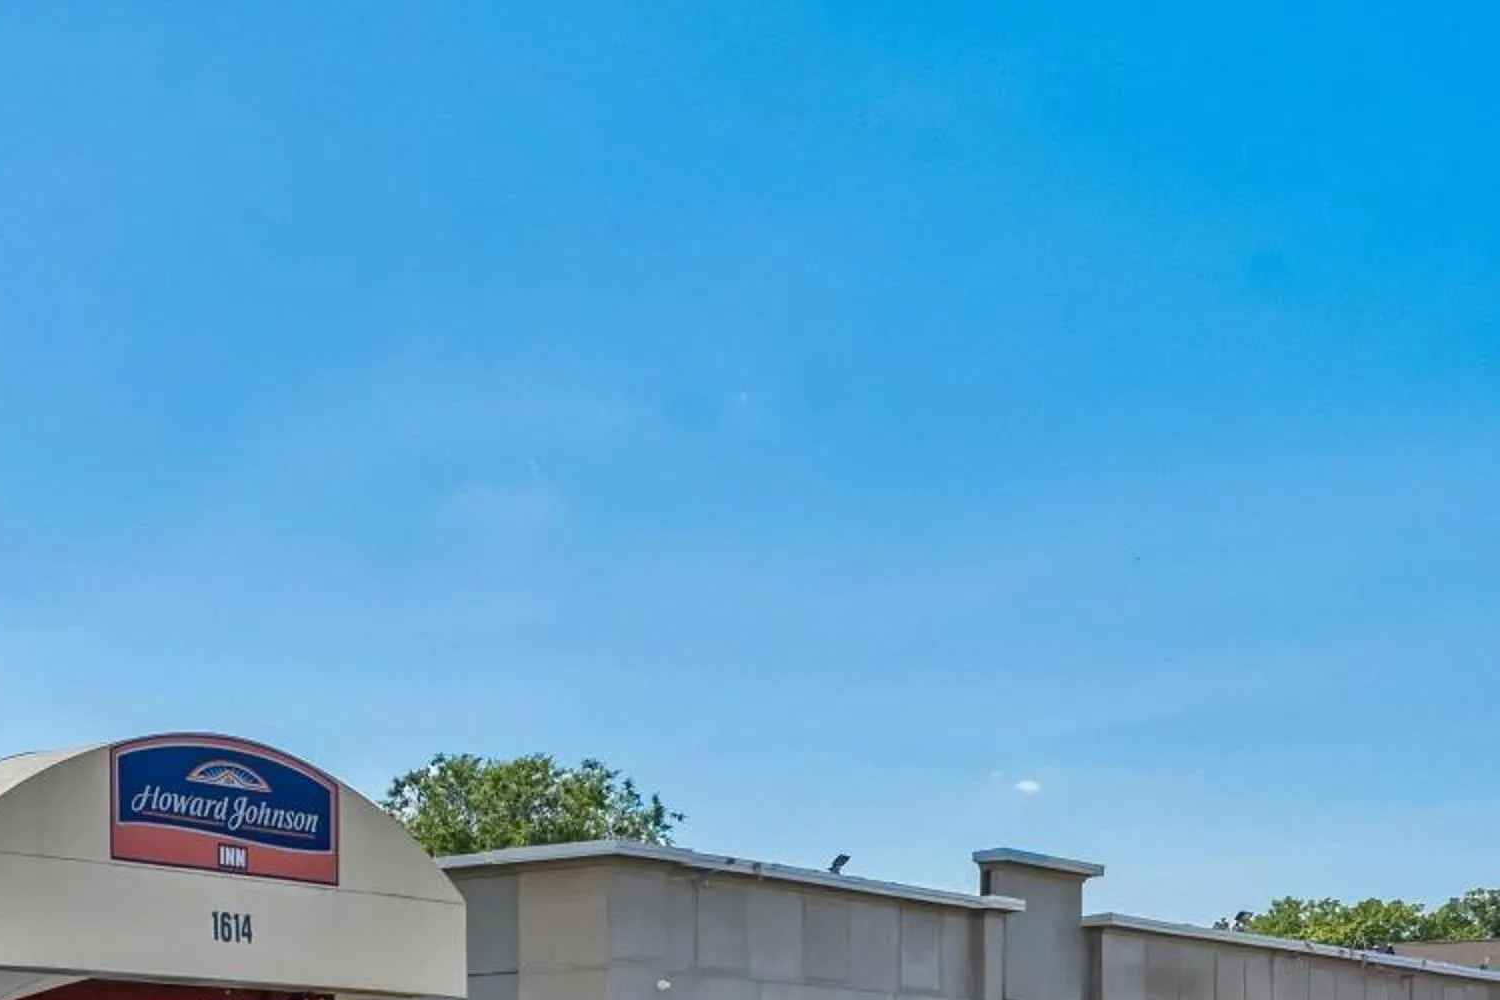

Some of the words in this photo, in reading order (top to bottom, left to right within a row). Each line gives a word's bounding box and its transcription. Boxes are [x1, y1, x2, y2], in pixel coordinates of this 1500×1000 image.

[131, 785, 229, 821] Howard
[227, 796, 319, 833] Johnson
[219, 846, 246, 868] INN
[211, 911, 253, 944] 1614
